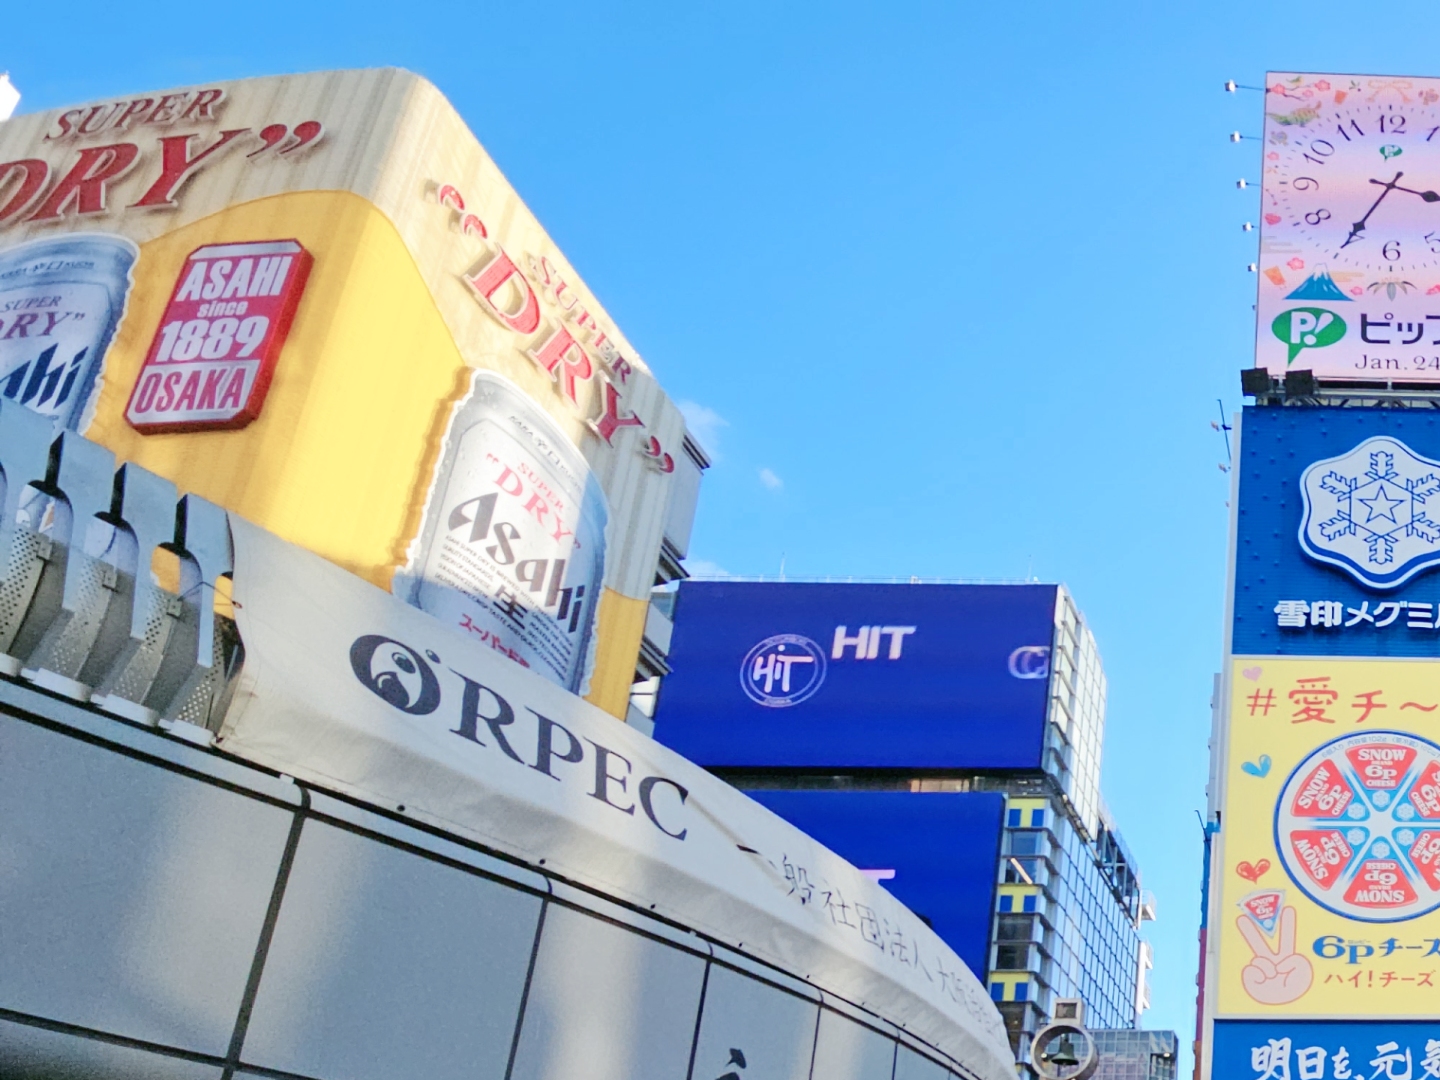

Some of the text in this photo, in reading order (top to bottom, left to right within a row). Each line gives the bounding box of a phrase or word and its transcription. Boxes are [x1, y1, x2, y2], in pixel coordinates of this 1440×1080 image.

[43, 88, 225, 142] SUPER
[1378, 114, 1407, 134] 12
[1336, 119, 1365, 142] 11
[1426, 125, 1440, 142] 1
[1303, 139, 1335, 165] 10
[1293, 176, 1319, 191] 9
[1305, 208, 1331, 225] 8
[1383, 240, 1401, 262] 6
[176, 255, 293, 302] ASAHI
[3, 295, 62, 313] SUPER
[198, 300, 248, 317] since
[0, 311, 86, 340] RY”
[534, 256, 632, 385] SUPER
[155, 315, 270, 363] 1889
[1354, 355, 1407, 371] Jan.
[135, 367, 249, 413] OSAKA
[519, 462, 566, 512] SUPER
[448, 492, 587, 634] Asahi
[831, 625, 917, 660] HIT
[1358, 749, 1407, 761] SNOW
[1298, 766, 1330, 809] SNOW
[1294, 839, 1329, 880] SNOW
[1354, 890, 1405, 903] SNOW
